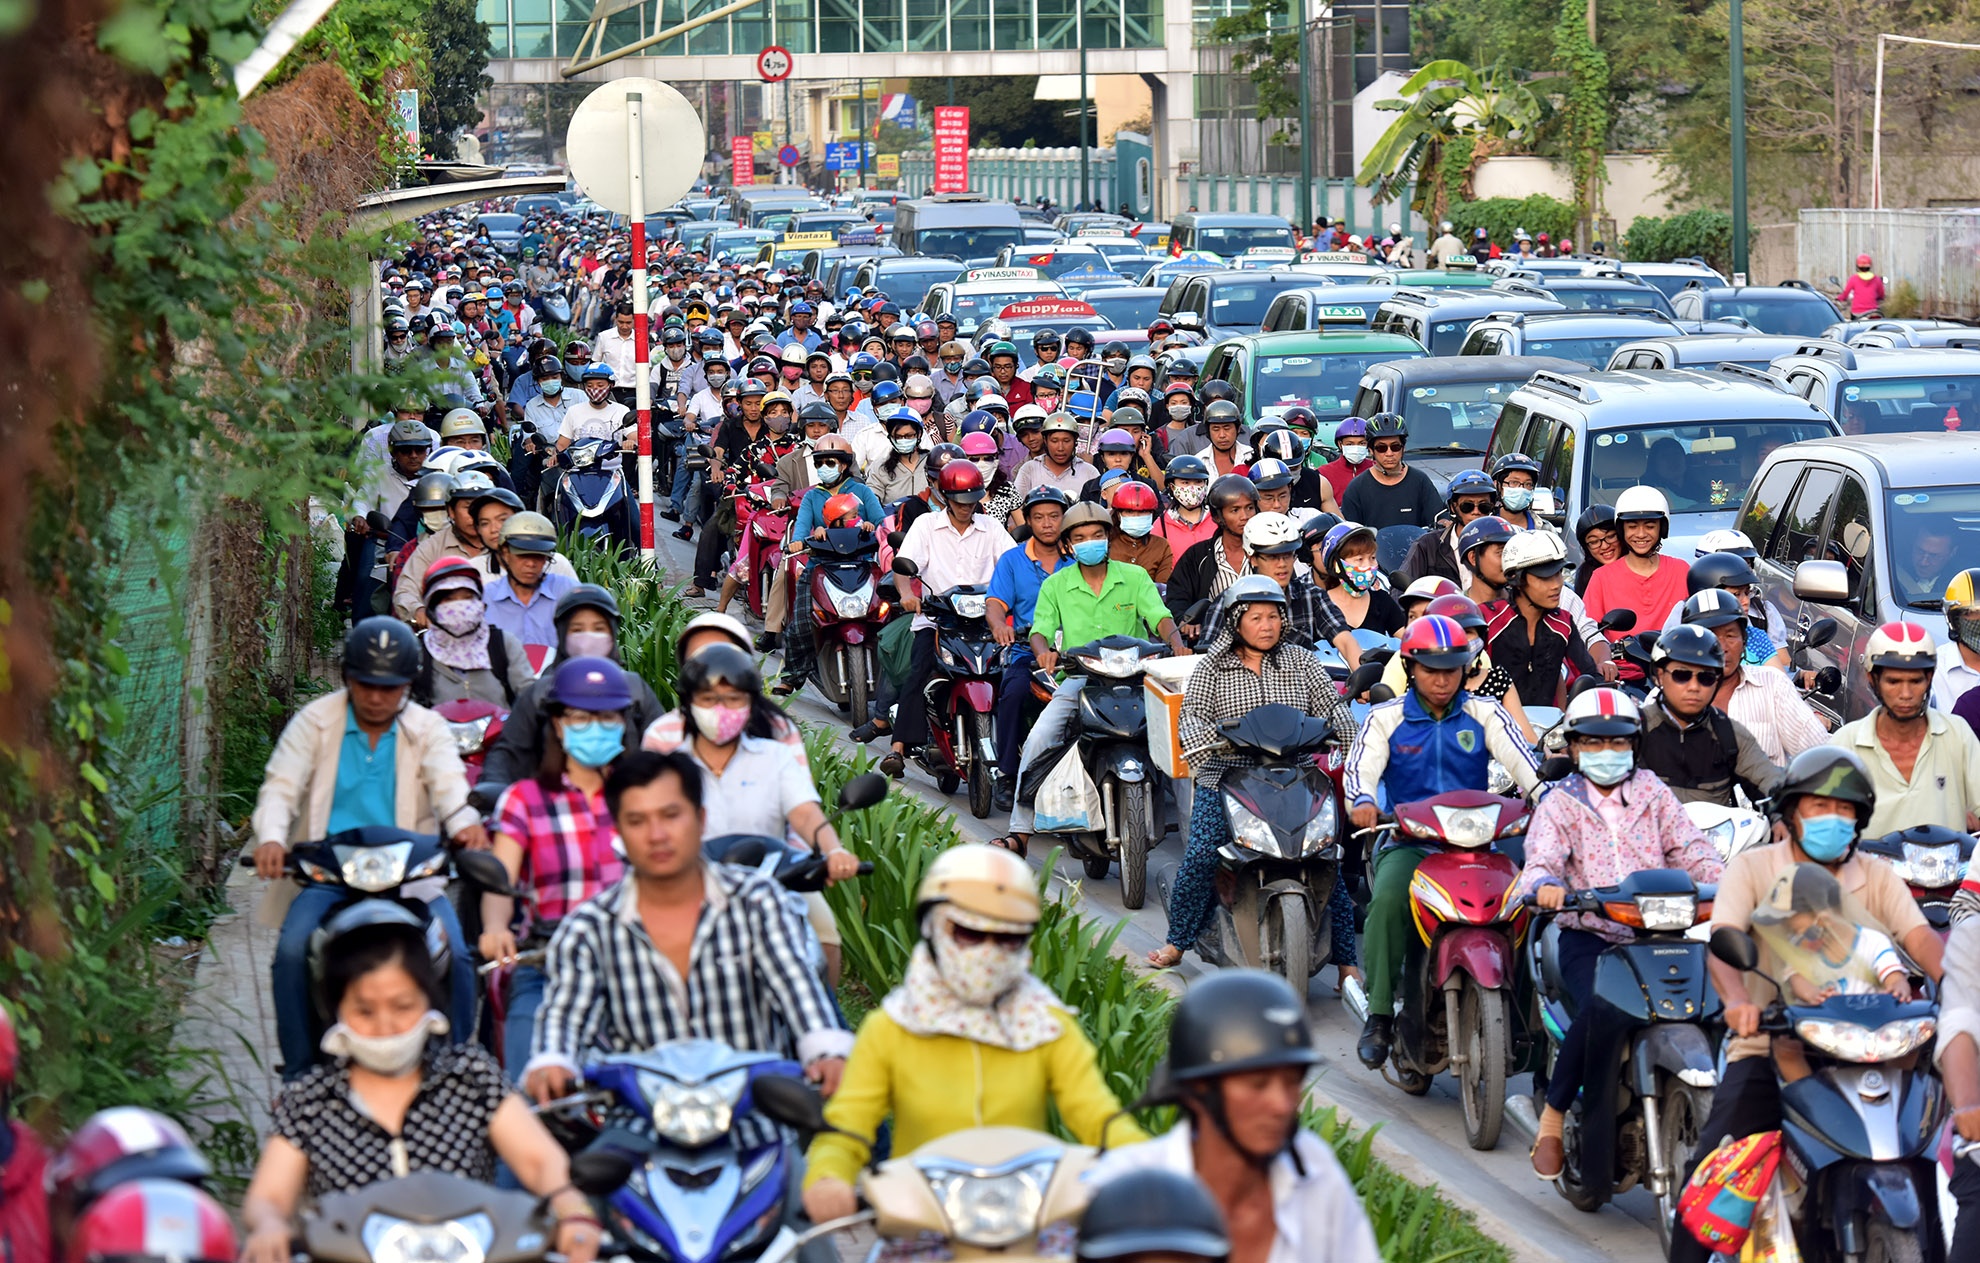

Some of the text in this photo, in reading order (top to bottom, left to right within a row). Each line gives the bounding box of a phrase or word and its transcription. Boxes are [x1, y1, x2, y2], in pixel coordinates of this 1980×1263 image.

[788, 232, 828, 240] Vinataxi
[1011, 304, 1085, 314] happy taxi
[665, 382, 678, 397] 7
